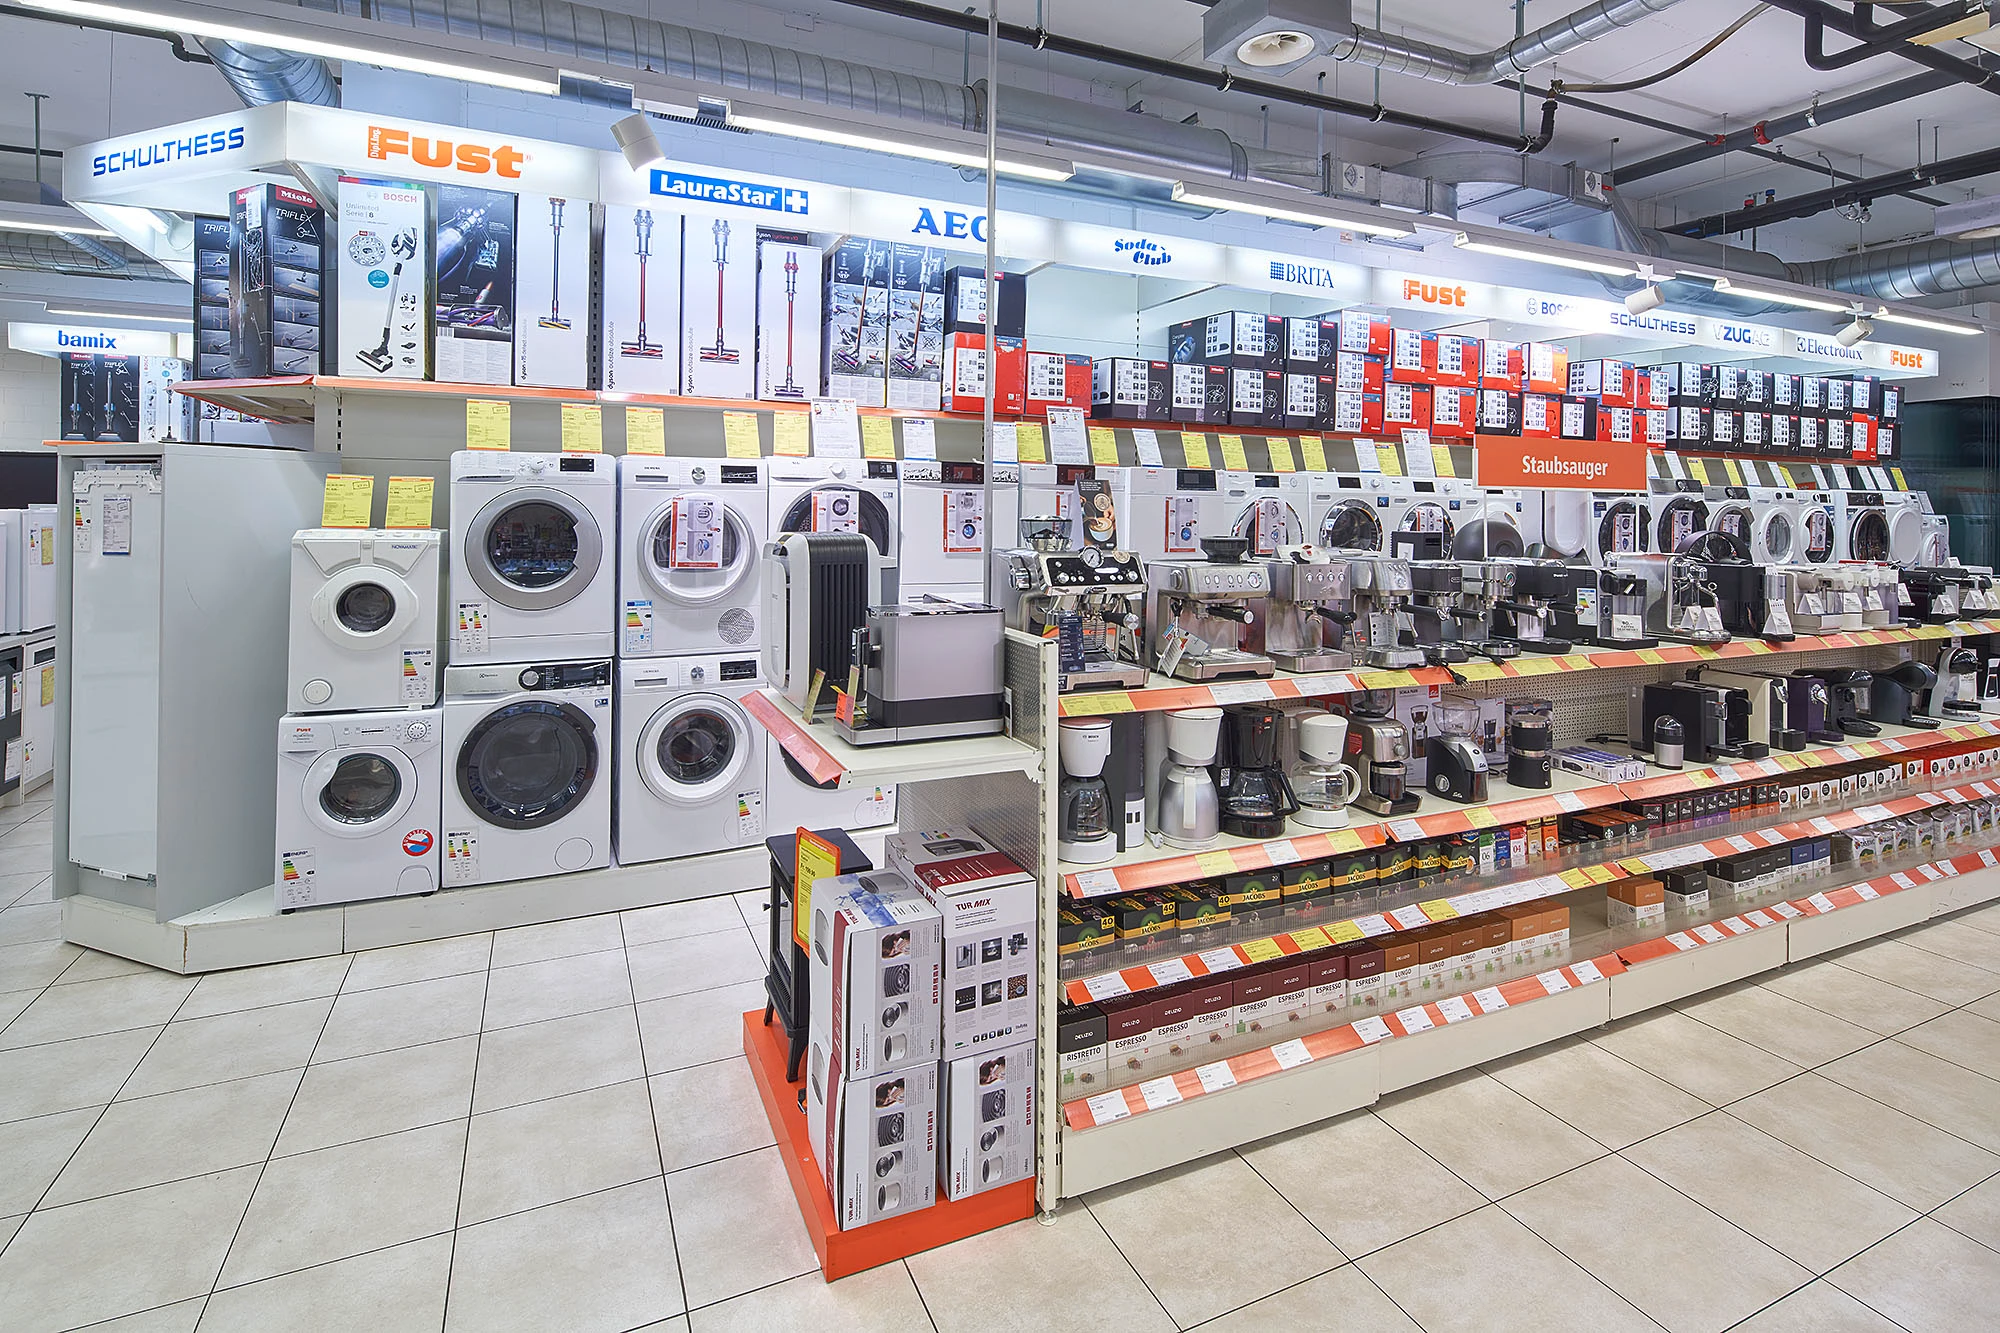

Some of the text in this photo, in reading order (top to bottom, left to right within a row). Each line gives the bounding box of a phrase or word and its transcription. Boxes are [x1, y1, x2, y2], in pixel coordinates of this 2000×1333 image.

[93, 127, 244, 177] SCHULTHESS
[368, 126, 524, 179] Fust
[660, 174, 776, 207] LauraStar
[281, 190, 313, 204] Miele
[383, 192, 417, 203] BOSCH
[345, 202, 380, 212] Unlimited
[345, 209, 365, 217] Serie
[204, 223, 231, 234] TRIFL
[1114, 238, 1157, 253] Soda
[1133, 250, 1172, 265] Club
[1286, 263, 1334, 289] BRITA
[1404, 279, 1466, 307] Fust
[1610, 312, 1696, 335] SCHULTHESS
[58, 330, 117, 349] bamix
[1807, 338, 1863, 361] Electrolux
[1890, 350, 1922, 368] Fust
[1522, 455, 1609, 480] Staubsauger
[1481, 852, 1491, 860] 06
[1420, 858, 1440, 868] JACOBS
[1347, 873, 1366, 883] JACOBS
[1298, 881, 1319, 892] JACOBS
[1219, 895, 1230, 904] 40
[1242, 892, 1266, 902] JACOBS
[955, 898, 992, 911] TUR MIX
[1102, 918, 1114, 926] 40
[1196, 915, 1217, 925] JACOBS
[1141, 925, 1161, 935] JACOBS
[1549, 931, 1563, 939] LUNGO
[1078, 940, 1100, 949] JACOBS
[1520, 938, 1536, 947] LUNGO
[1491, 945, 1507, 954] LUNGO
[1460, 953, 1476, 962] LUNGO
[1429, 961, 1445, 970] LUNGO
[1321, 968, 1337, 976] DELIZIO
[1395, 969, 1412, 978] LUNGO
[1284, 977, 1299, 985] DELIZIO
[1355, 976, 1381, 988] ESPRESSO
[1246, 986, 1262, 994] DELIZIO
[1315, 982, 1342, 994] ESPRESSO
[1205, 996, 1222, 1004] DELIZIO
[1278, 991, 1305, 1003] ESPRESSO
[1164, 1007, 1182, 1016] DELIZIO
[1239, 1001, 1268, 1013] ESPRESSO
[1198, 1011, 1228, 1023] ESPRESSO
[1122, 1019, 1141, 1028] DELIZIO
[1158, 1023, 1189, 1035] ESPRESSO
[1074, 1031, 1094, 1041] DELIZIO
[1115, 1035, 1147, 1048] ESPRESSO
[1067, 1047, 1101, 1061] RISTRETTO
